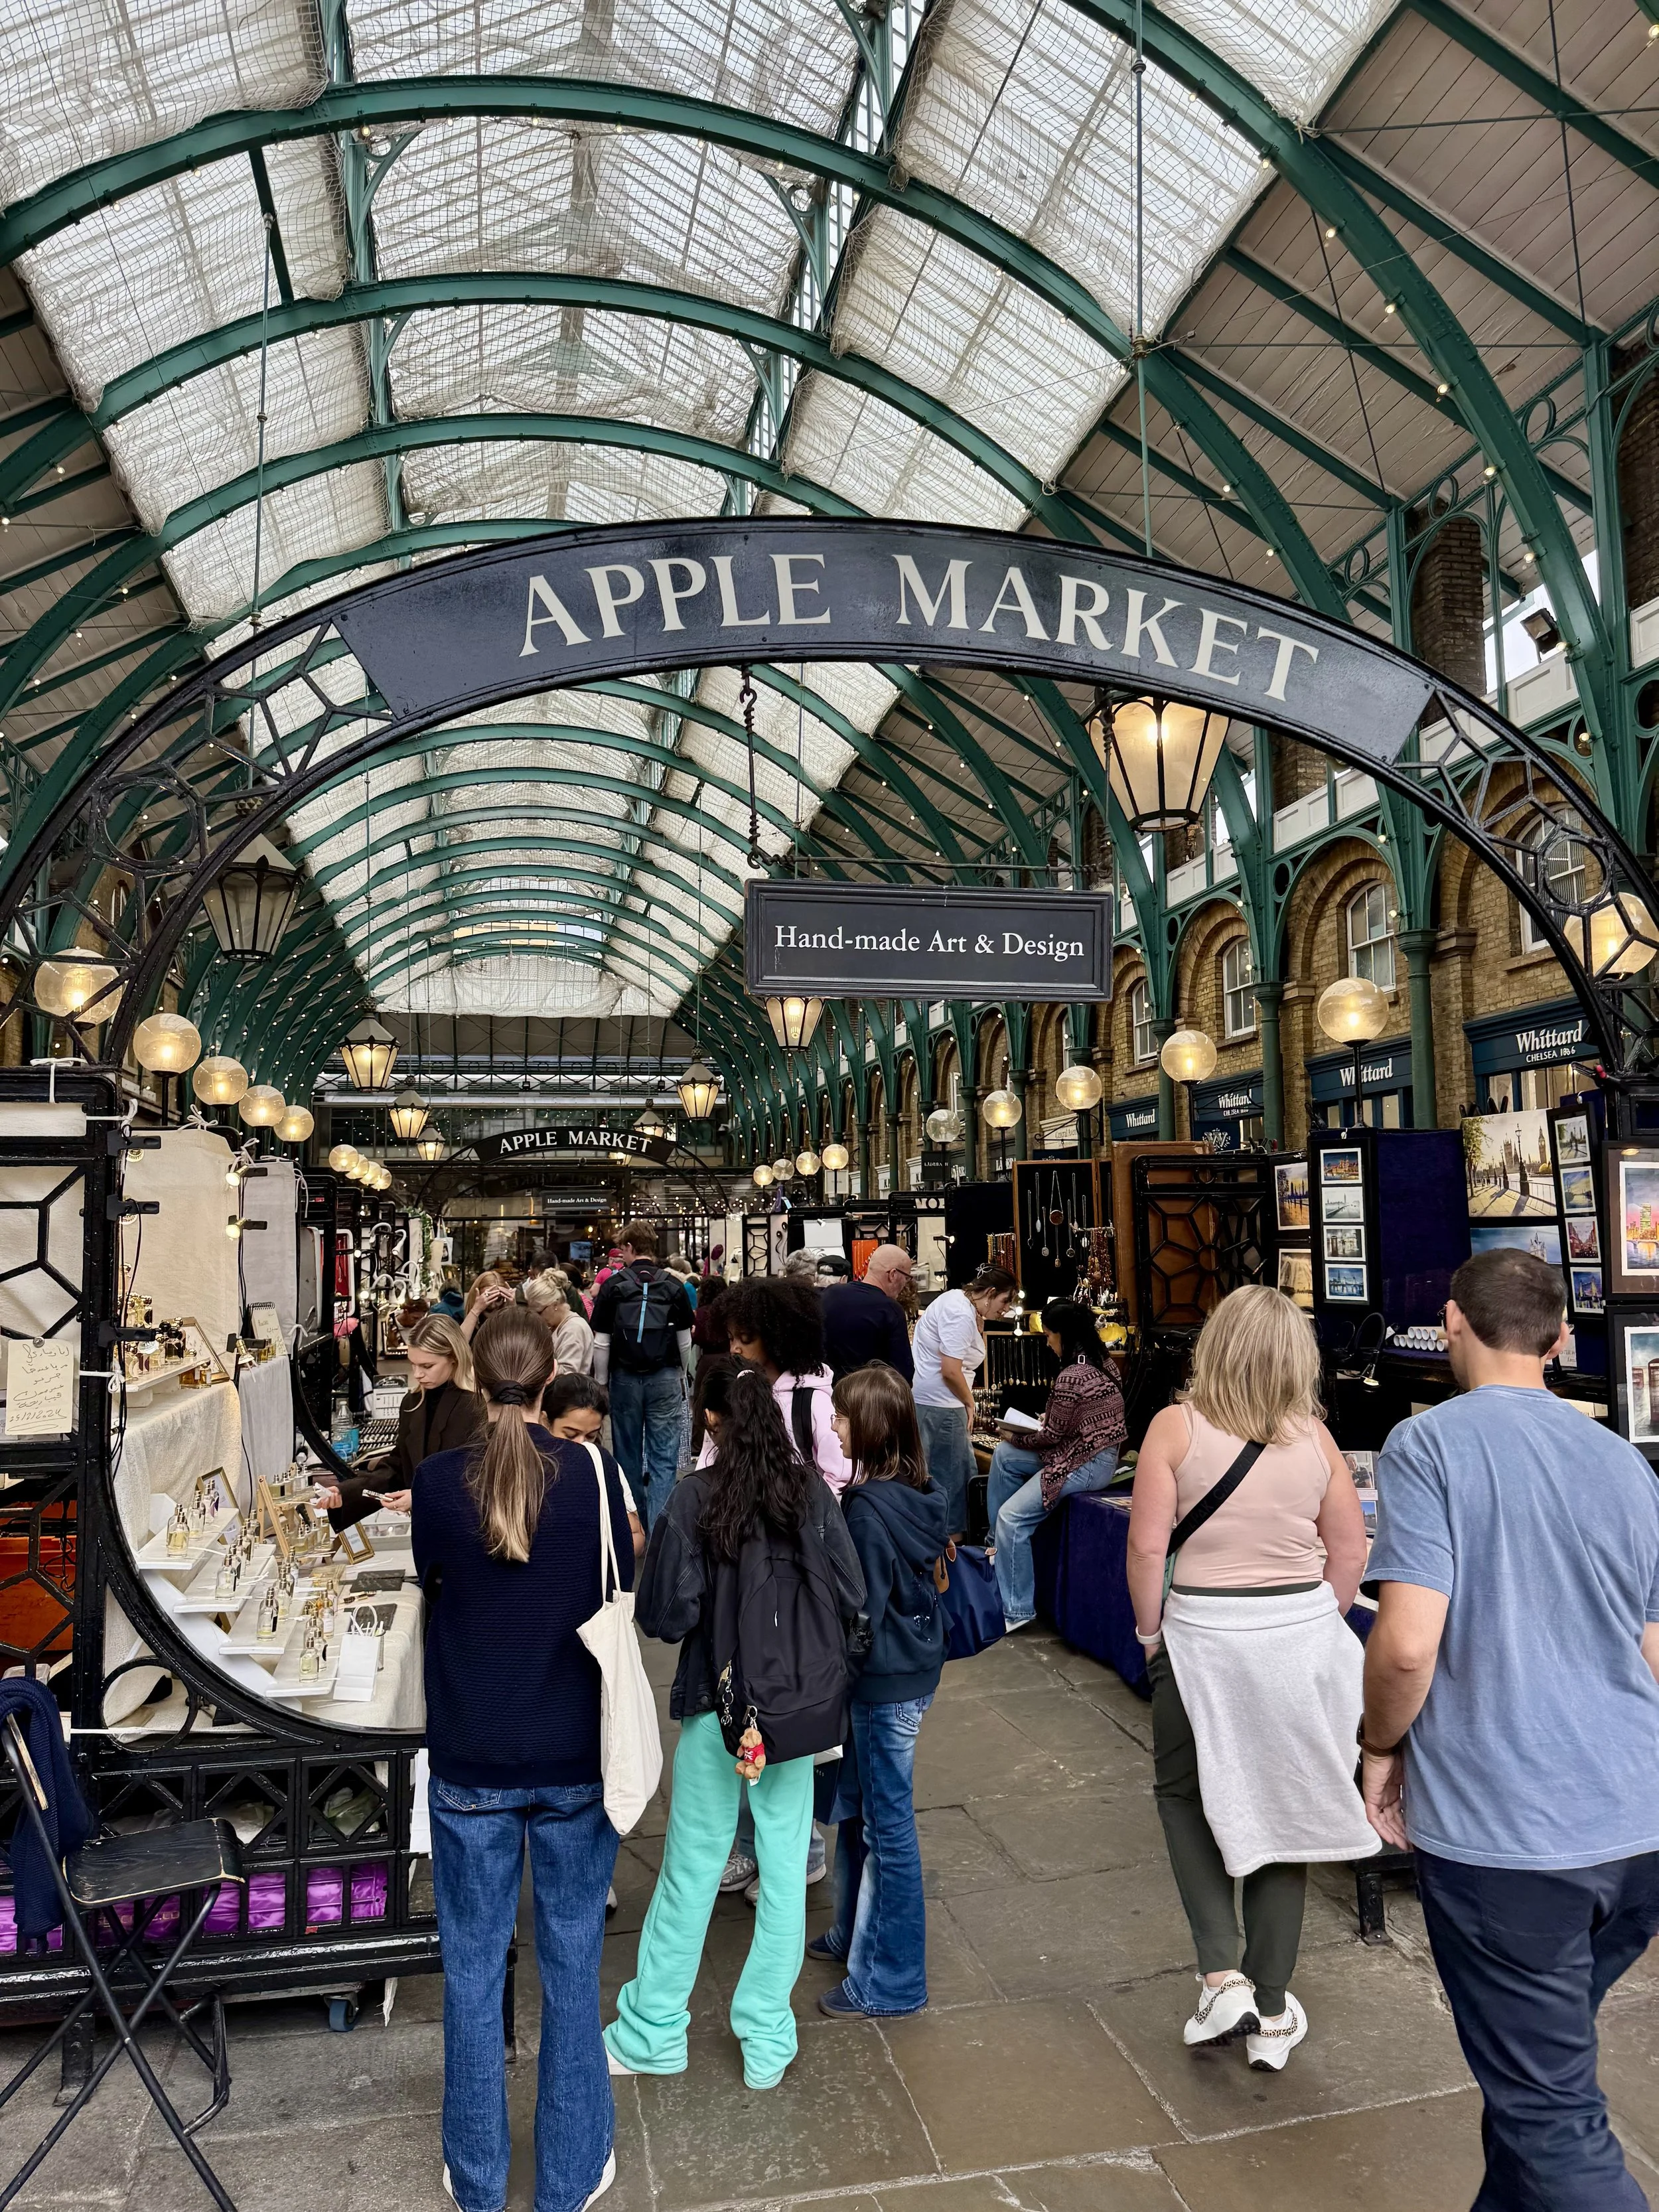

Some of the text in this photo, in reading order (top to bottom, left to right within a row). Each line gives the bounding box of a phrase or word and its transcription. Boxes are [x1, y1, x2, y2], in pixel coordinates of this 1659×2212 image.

[519, 553, 1319, 702] APPLE MARKET
[774, 925, 1084, 962] Hand-made Art & Design
[1516, 1019, 1583, 1053] Whittard
[1526, 1050, 1558, 1063] CHELSEA
[1125, 1108, 1156, 1128] Whittard
[500, 1131, 652, 1153] APPLE MARKET
